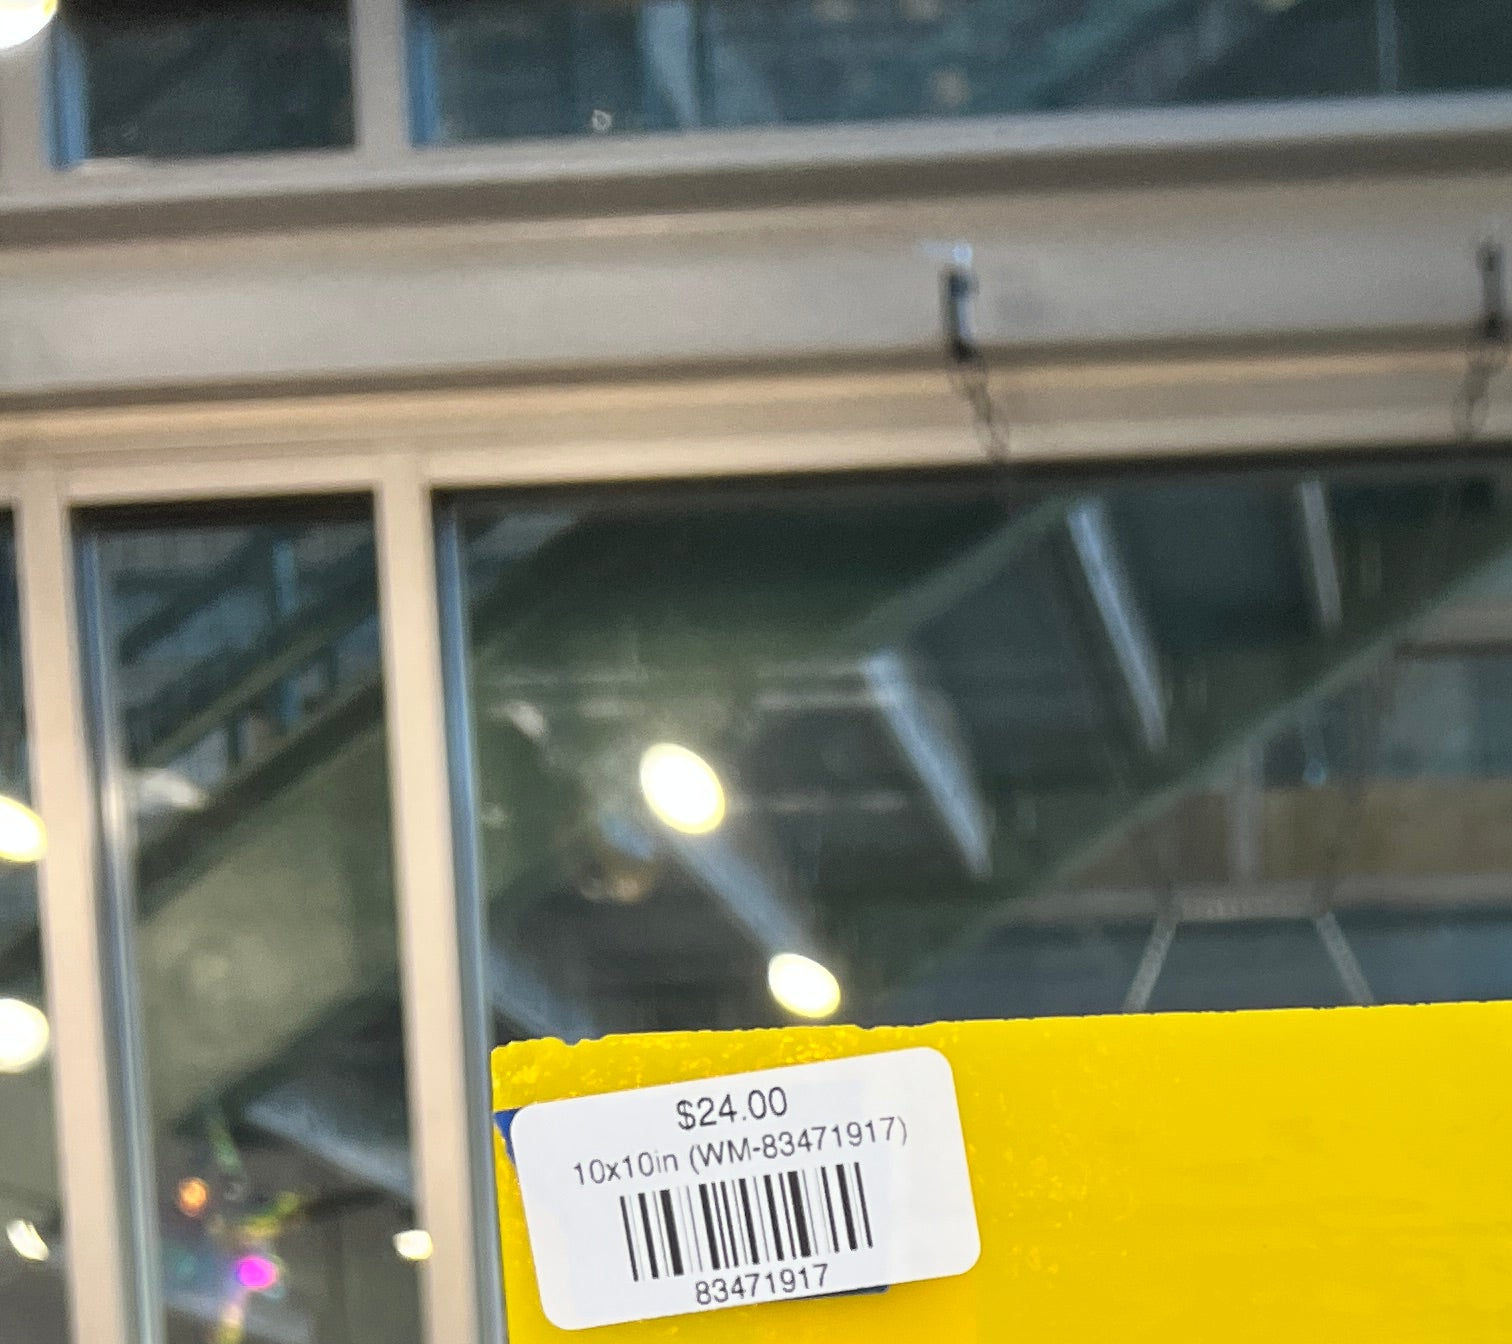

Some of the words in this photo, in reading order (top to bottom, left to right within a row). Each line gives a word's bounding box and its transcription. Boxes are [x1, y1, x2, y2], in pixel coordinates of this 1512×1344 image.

[676, 1085, 788, 1131] $24.00
[573, 1150, 679, 1186] 10x10in
[689, 1115, 908, 1175] (WM-83471917)
[695, 1262, 829, 1306] 83471917
